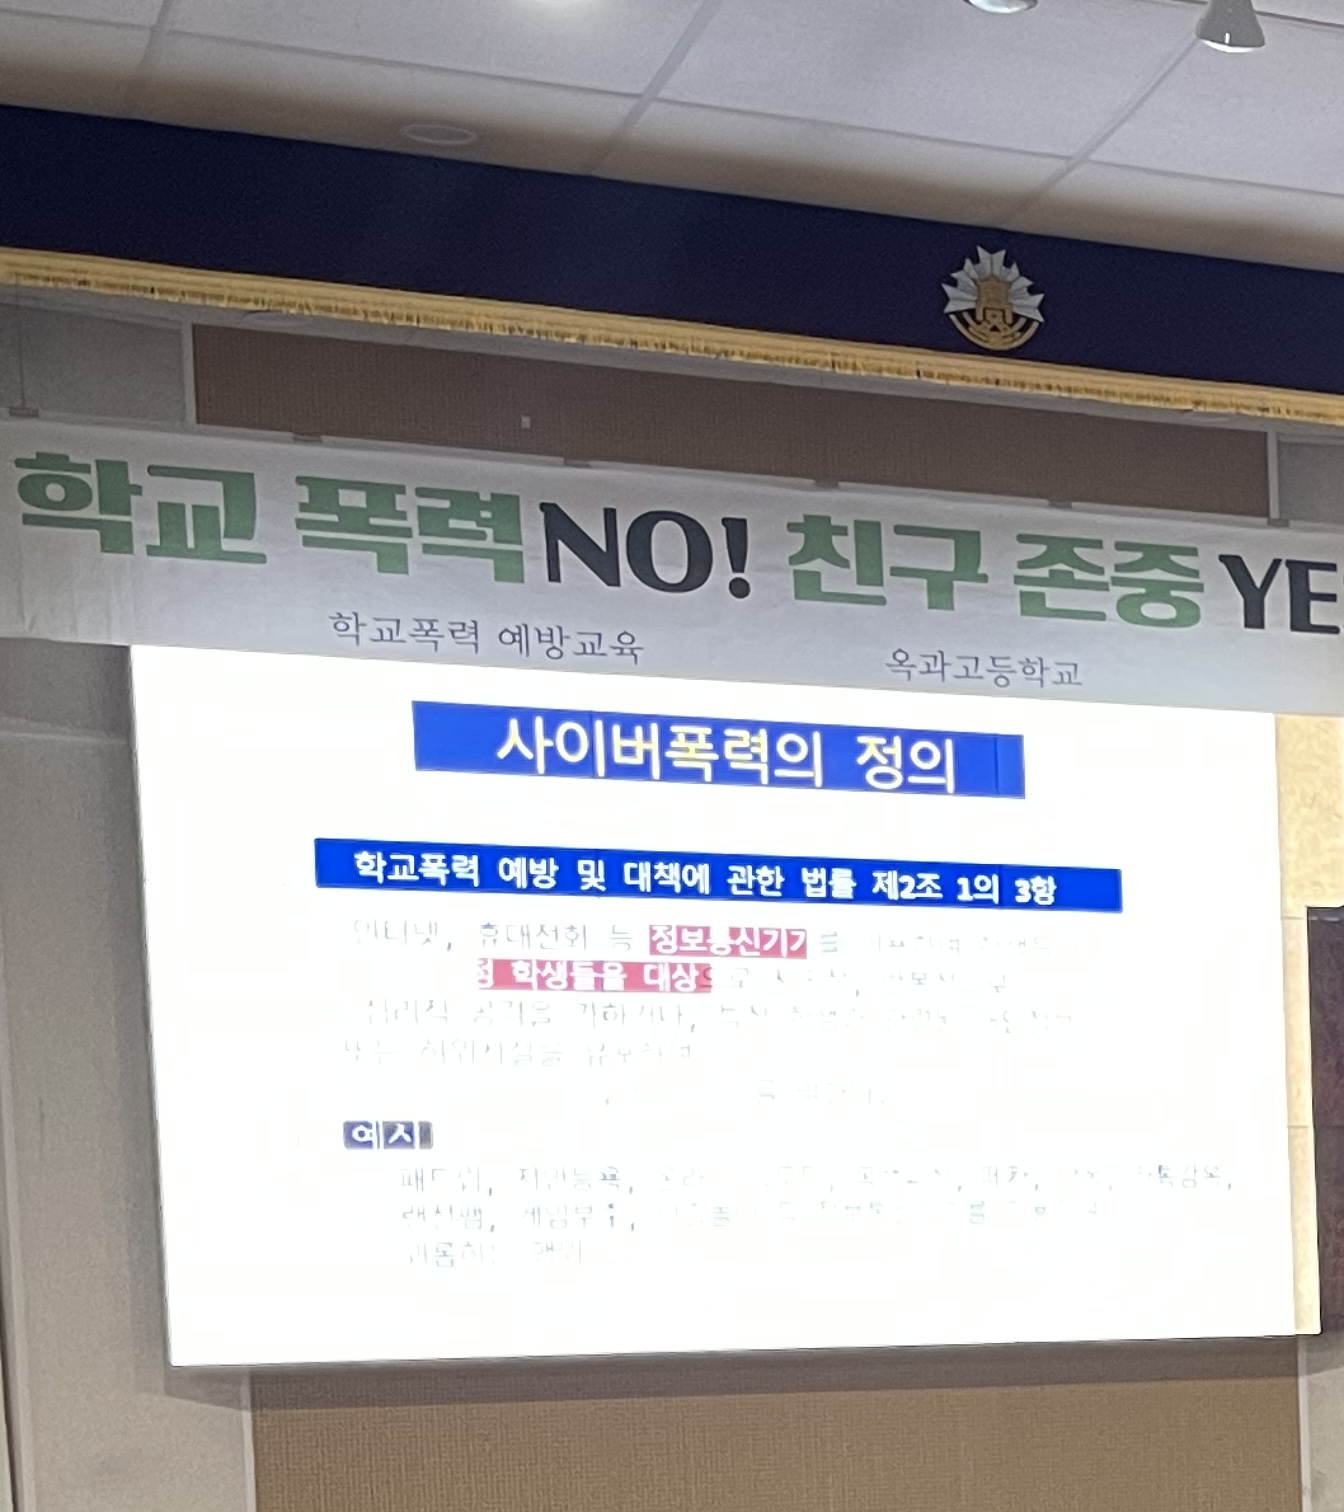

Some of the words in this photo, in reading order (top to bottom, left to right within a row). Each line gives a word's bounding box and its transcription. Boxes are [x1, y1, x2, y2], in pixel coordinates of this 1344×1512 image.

[15, 451, 267, 564] 학교
[295, 474, 525, 584] 폭력
[538, 500, 752, 600] NO!
[786, 513, 989, 611] 친구
[1013, 532, 1205, 629] 존중
[328, 611, 480, 655] 학교폭력
[498, 623, 645, 666] 예방교육
[885, 648, 1083, 688] 옥과고등학교
[497, 716, 823, 788] 사이버폭력의
[856, 735, 955, 794] 정의
[354, 851, 480, 887] 학교폭력
[499, 856, 559, 888] 예방
[577, 859, 606, 892] 및
[623, 860, 710, 894] 대책에
[727, 864, 785, 896] 관한
[801, 867, 857, 899] 법률
[873, 870, 943, 900] 제2조
[957, 873, 999, 905] 1의
[1015, 875, 1057, 906] 3항
[511, 960, 627, 992] 학생들을
[351, 1120, 420, 1149] 예시
